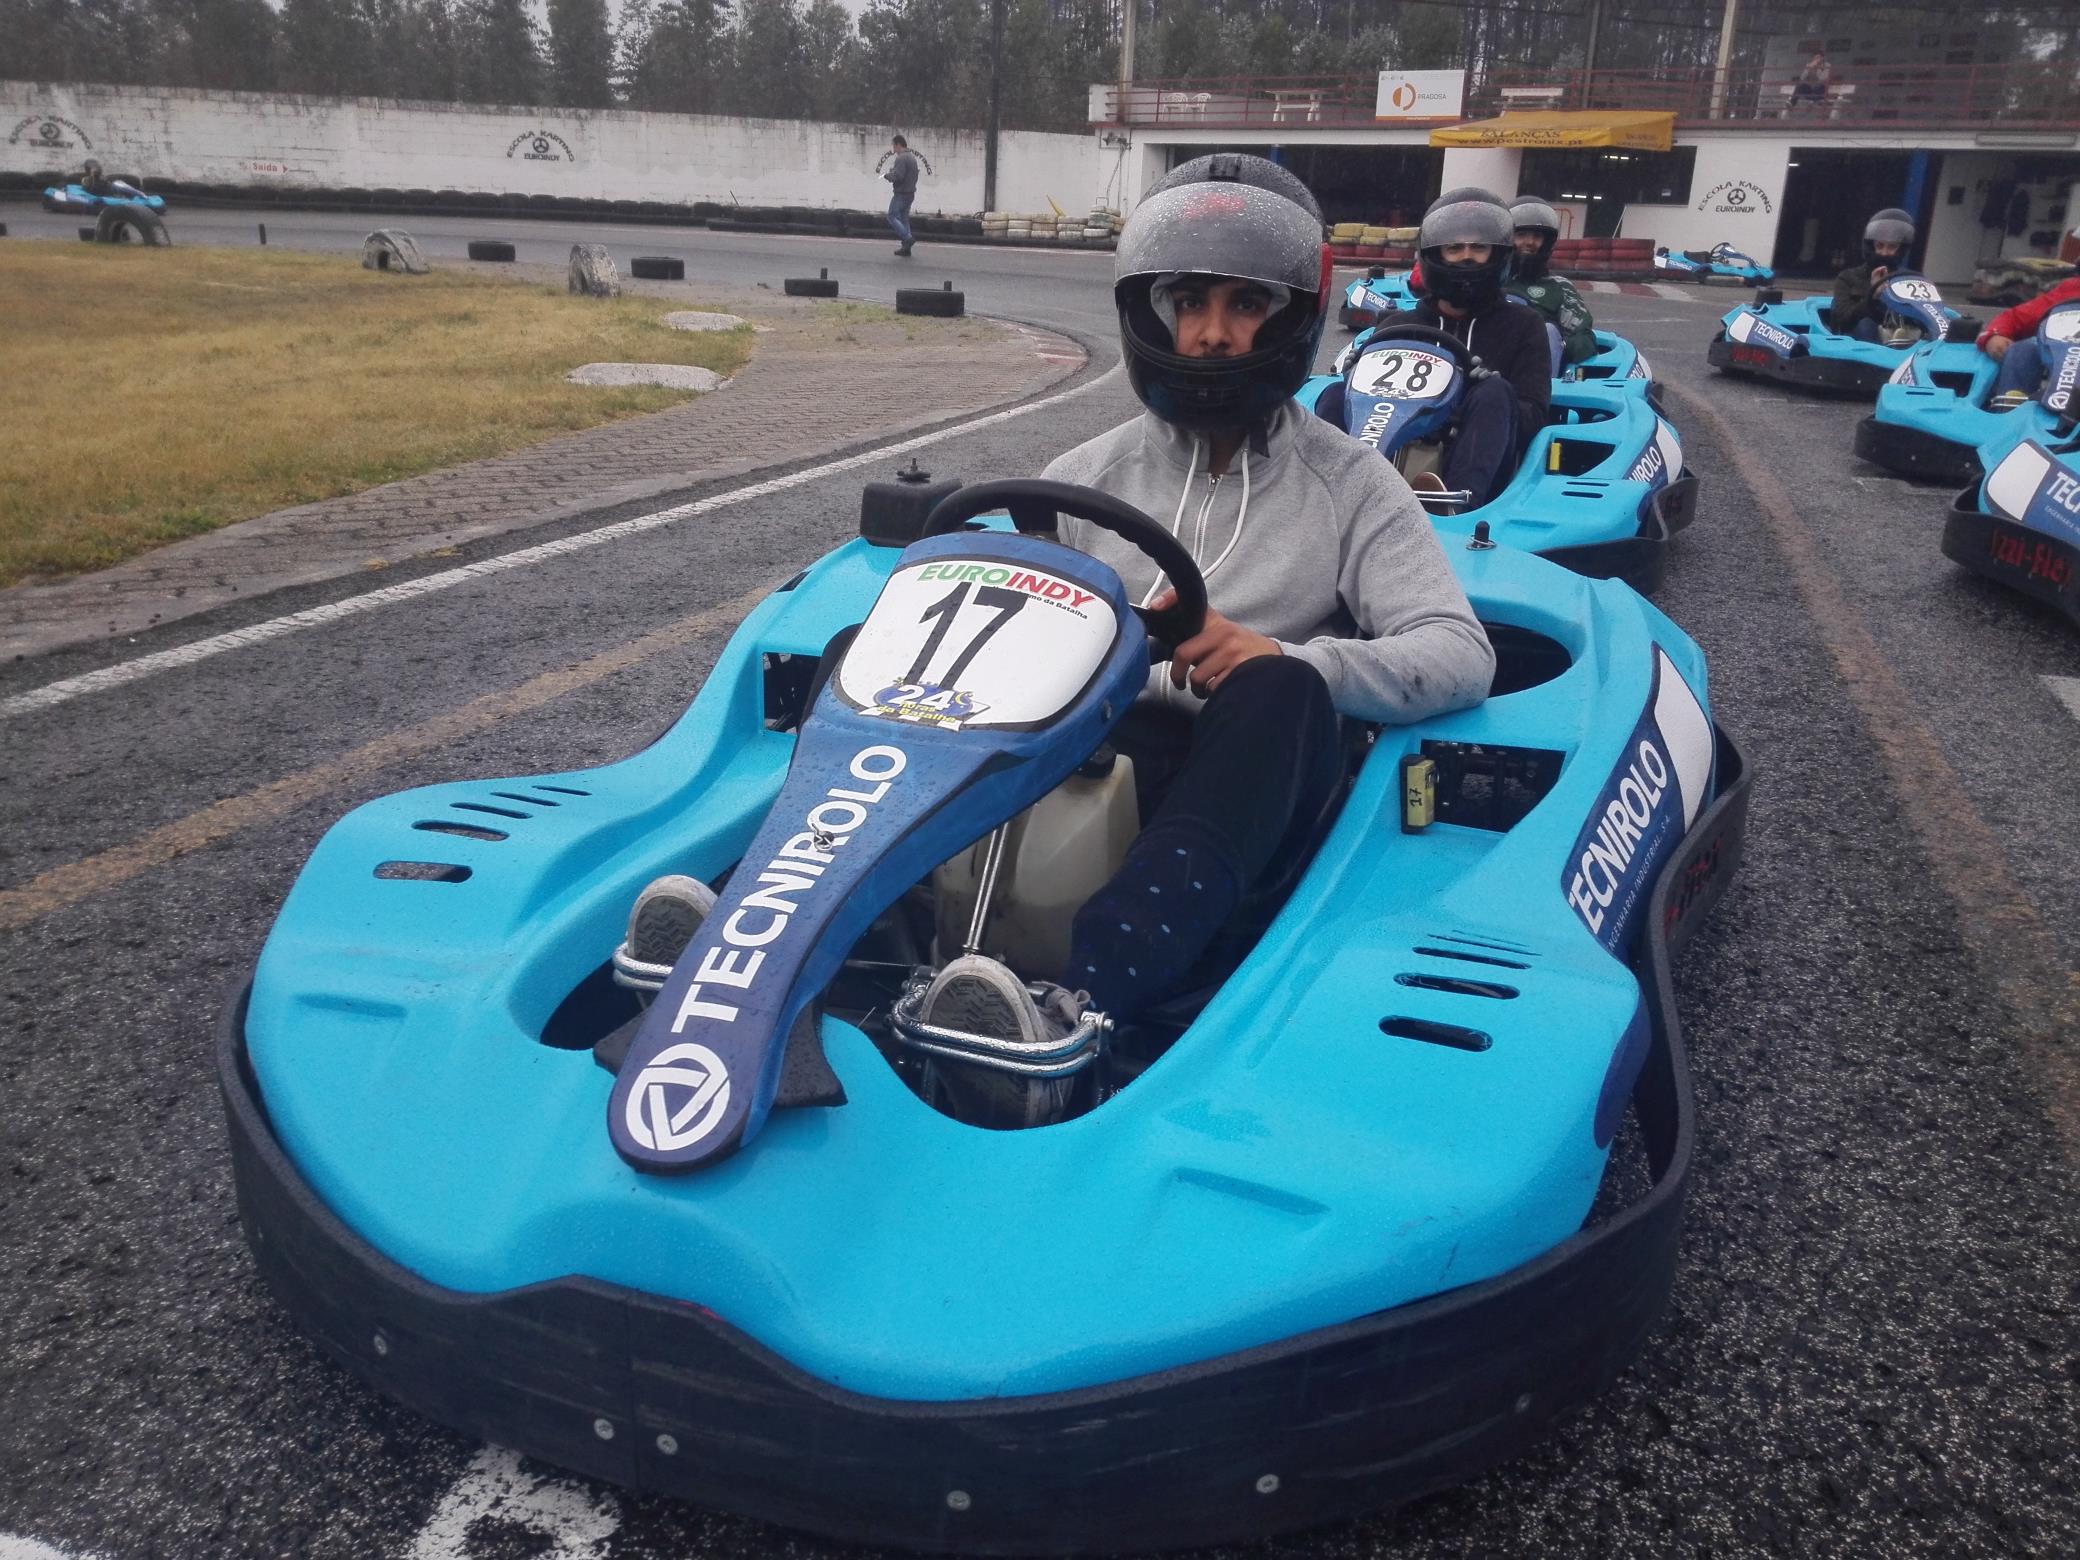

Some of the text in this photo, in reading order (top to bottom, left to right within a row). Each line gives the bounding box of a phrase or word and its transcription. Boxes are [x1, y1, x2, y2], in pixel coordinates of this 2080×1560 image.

[507, 129, 576, 162] ESCOLA KARTING
[1698, 180, 1772, 213] ESCOLA KARTING
[1715, 205, 1756, 213] EUROINDY
[1906, 283, 1931, 298] 23
[1754, 321, 1795, 350] TECNIROLO
[1372, 355, 1432, 392] 28
[2046, 471, 2080, 513] TEC
[916, 563, 1095, 608] EUROINDY
[1043, 598, 1088, 620] da Batalha
[903, 582, 1029, 690] 17
[887, 684, 955, 711] 24
[898, 708, 957, 722] Batalha
[1408, 787, 1422, 808] 17
[670, 745, 907, 1033] TECNIROLO
[1607, 889, 1638, 951] NGENHARIA
